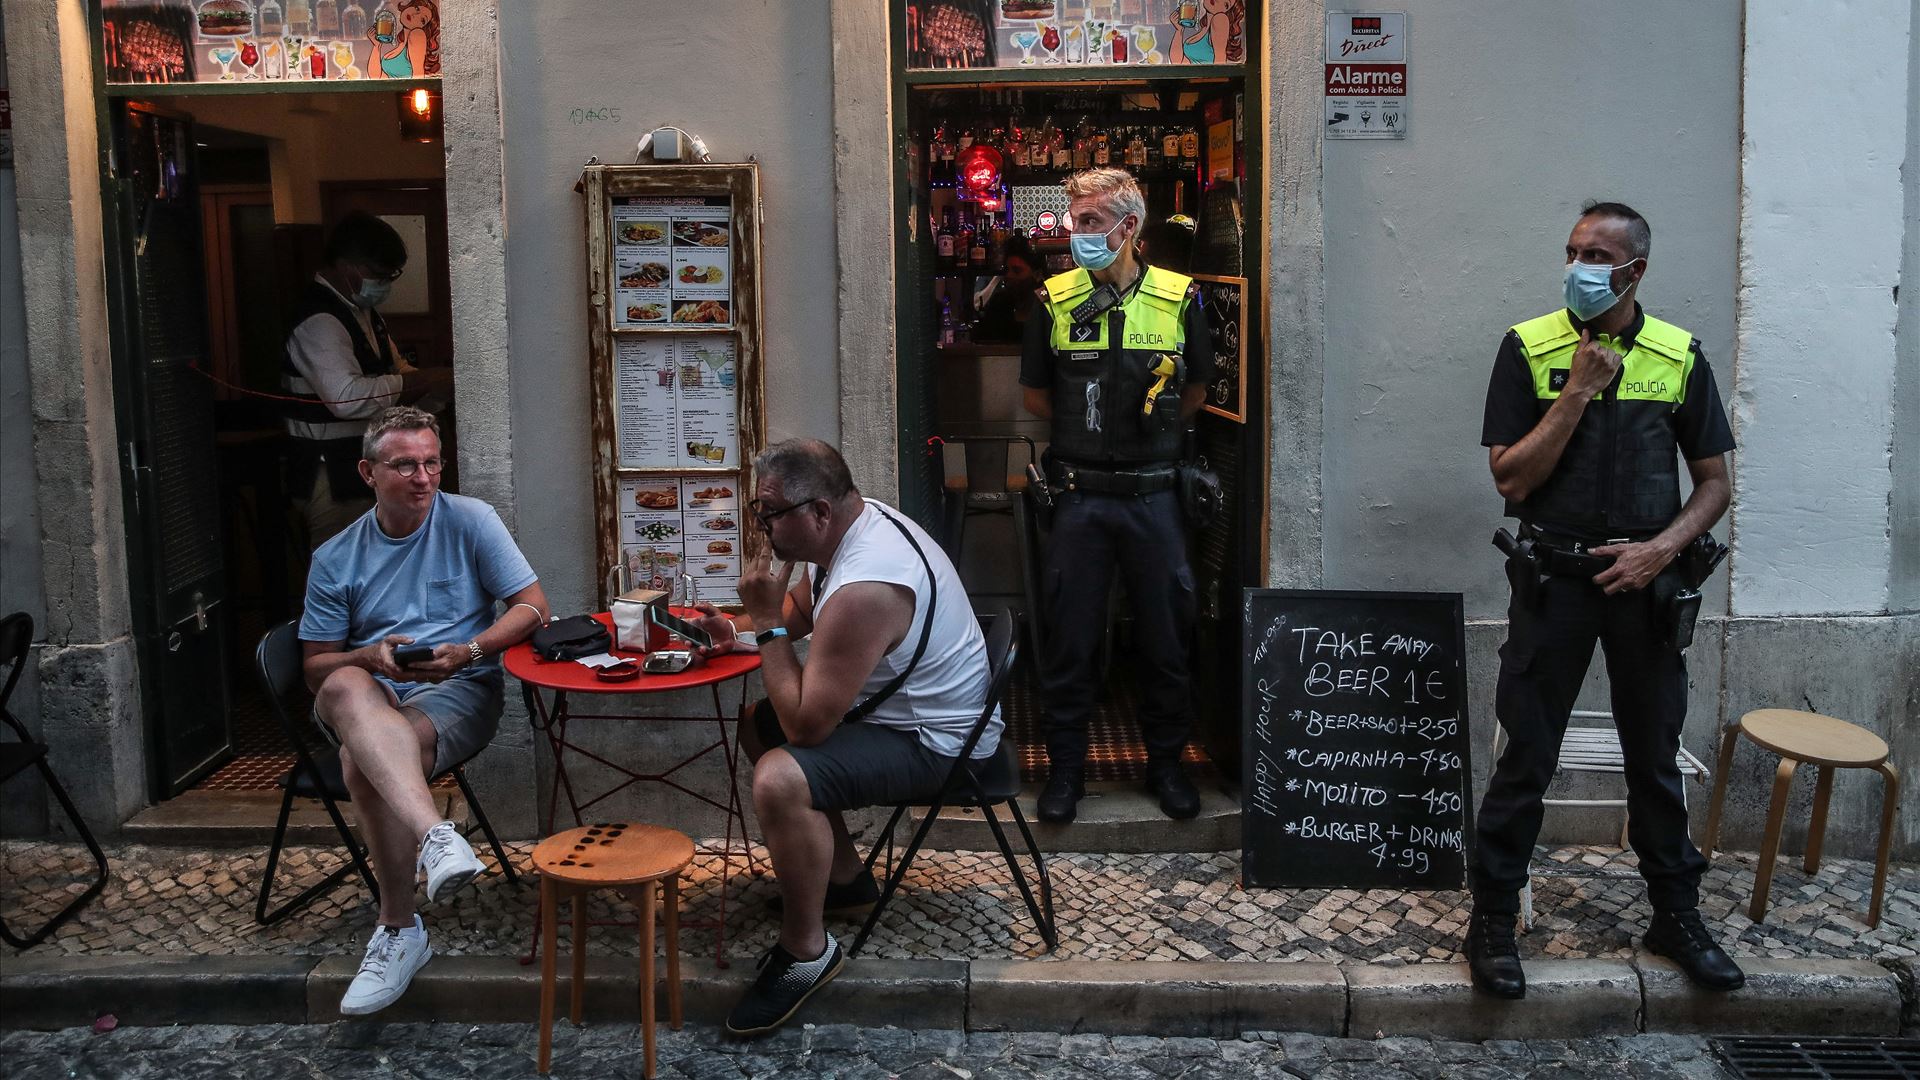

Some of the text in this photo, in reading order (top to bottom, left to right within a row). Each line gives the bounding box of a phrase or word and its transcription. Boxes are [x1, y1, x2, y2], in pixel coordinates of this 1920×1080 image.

[1340, 34, 1395, 57] Direct
[1329, 67, 1403, 84] Alarme
[1348, 86, 1369, 94] Aviso
[1378, 86, 1404, 94] Polícia
[1129, 332, 1164, 345] POLÍCIA
[1626, 379, 1667, 394] POLÍCIA
[1292, 627, 1434, 663] TAKE AWAY
[1304, 662, 1390, 698] BEER
[1252, 678, 1284, 817] HAPPY HOUR
[1305, 779, 1387, 807] MOJITO
[1300, 817, 1382, 843] BURGER
[1368, 842, 1430, 874] 4.99
